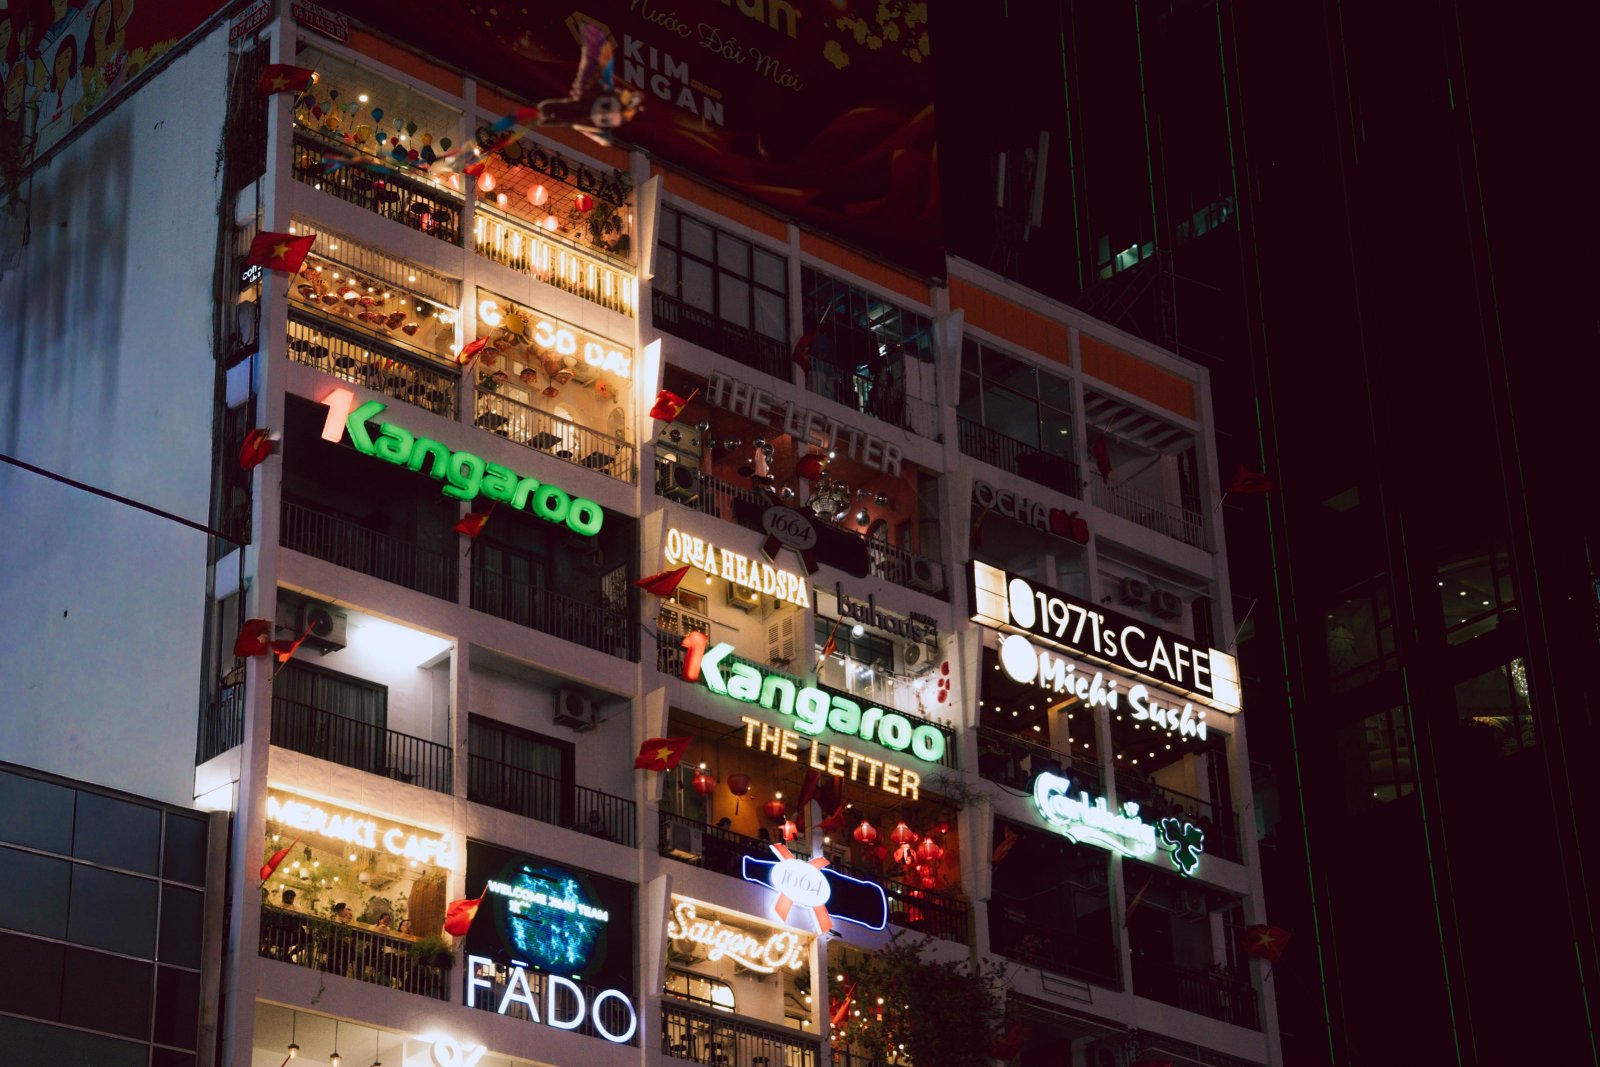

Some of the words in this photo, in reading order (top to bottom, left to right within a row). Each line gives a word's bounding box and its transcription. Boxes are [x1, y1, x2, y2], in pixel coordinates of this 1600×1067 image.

[624, 33, 689, 85] KIM
[624, 58, 725, 127] NGAN
[706, 371, 775, 425] THE
[785, 400, 902, 477] LETTER
[771, 513, 811, 542] 1664
[974, 480, 1052, 534] OCHA
[720, 548, 810, 608] HEADSPA
[1120, 625, 1213, 694] CAFE
[1038, 651, 1118, 711] Michi
[1127, 684, 1208, 742] Sushi
[741, 715, 800, 761] THE
[809, 740, 921, 800] LETTER
[267, 796, 377, 849] MERAKI
[487, 879, 547, 906] WELCOME
[576, 903, 609, 922] TEAM
[781, 868, 824, 897] 1664
[667, 902, 767, 962] Saigon
